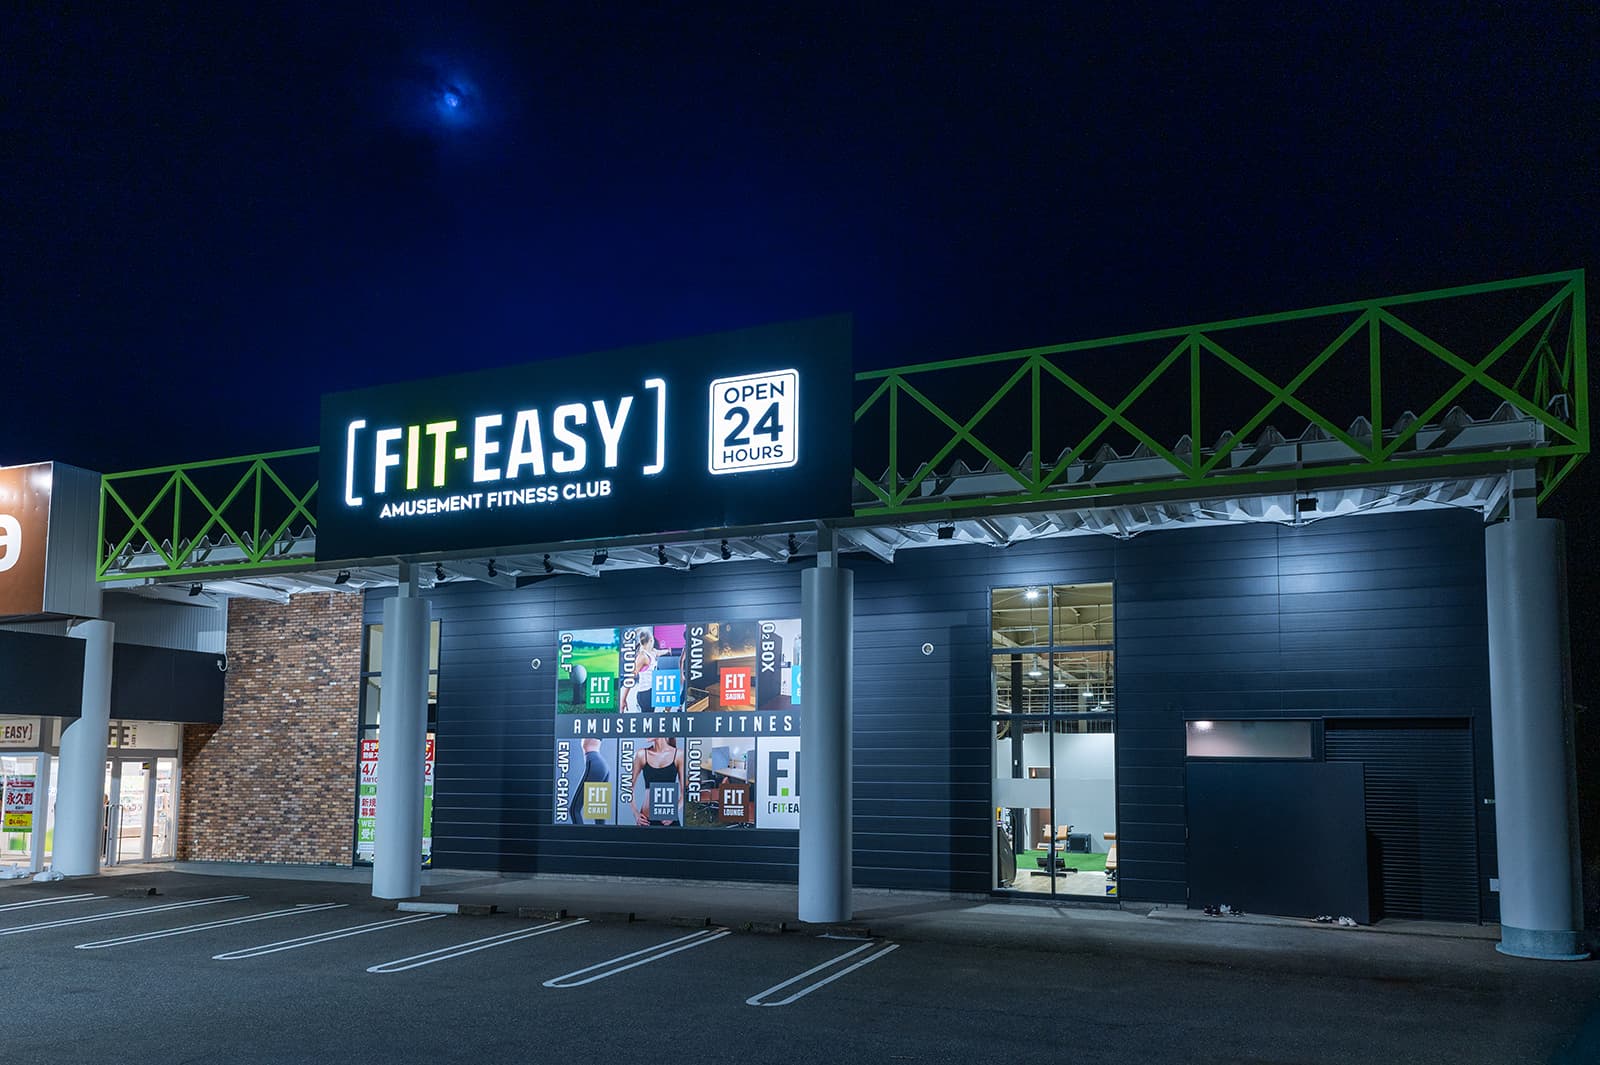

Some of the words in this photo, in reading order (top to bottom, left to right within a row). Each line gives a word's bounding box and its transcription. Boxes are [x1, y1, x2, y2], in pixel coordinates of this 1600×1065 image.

[724, 381, 784, 404] OPEN
[724, 402, 783, 447] 24
[723, 445, 783, 463] HOURS
[379, 494, 482, 518] AMUSEMENT
[486, 484, 559, 508] FITNESS
[562, 480, 612, 500] CLUB
[561, 634, 573, 672] GOLF
[623, 631, 636, 688] STUDIO
[690, 627, 703, 680] SAUNA
[590, 677, 610, 692] FIT
[656, 675, 676, 691] FIT
[725, 674, 746, 689] FIT
[656, 695, 676, 703] AERO
[573, 717, 694, 734] AMUSEMENT
[715, 716, 793, 732] FITNES
[621, 741, 633, 772] EMP
[556, 742, 569, 821] EMP-CHAIR
[688, 740, 701, 802] LOUNGE
[588, 787, 607, 802] FIT
[620, 773, 633, 803] M/C
[654, 788, 674, 803] FIT
[724, 789, 744, 805] FIT
